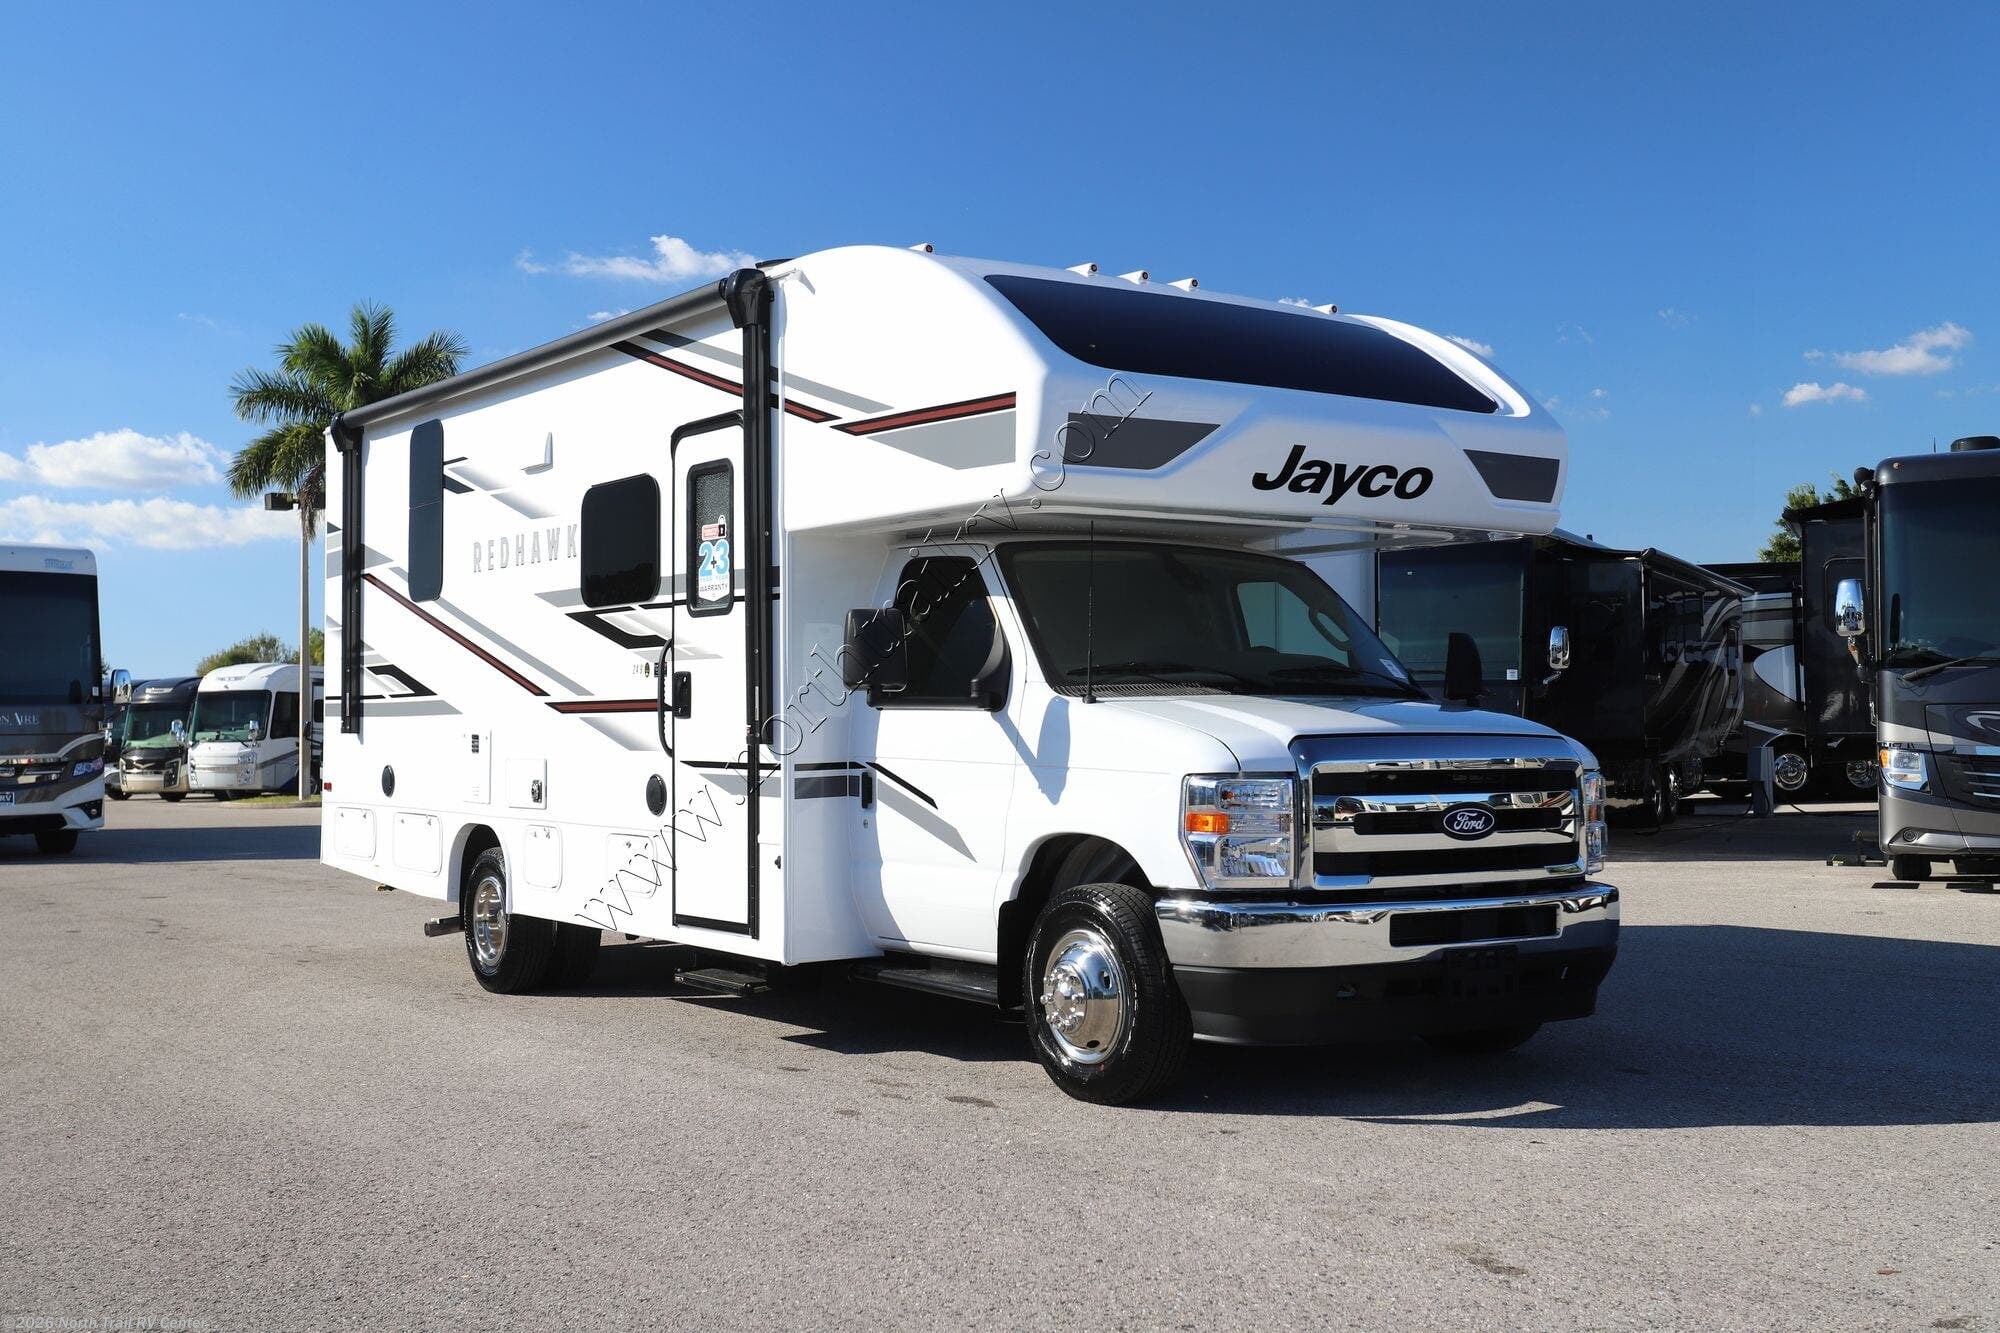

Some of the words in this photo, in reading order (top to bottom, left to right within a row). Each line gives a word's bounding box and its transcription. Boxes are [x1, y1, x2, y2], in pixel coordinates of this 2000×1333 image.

[1252, 444, 1434, 506] Jayco
[473, 523, 578, 573] REDHAWK
[699, 582, 729, 592] WARRANTY
[1453, 811, 1486, 830] Ford
